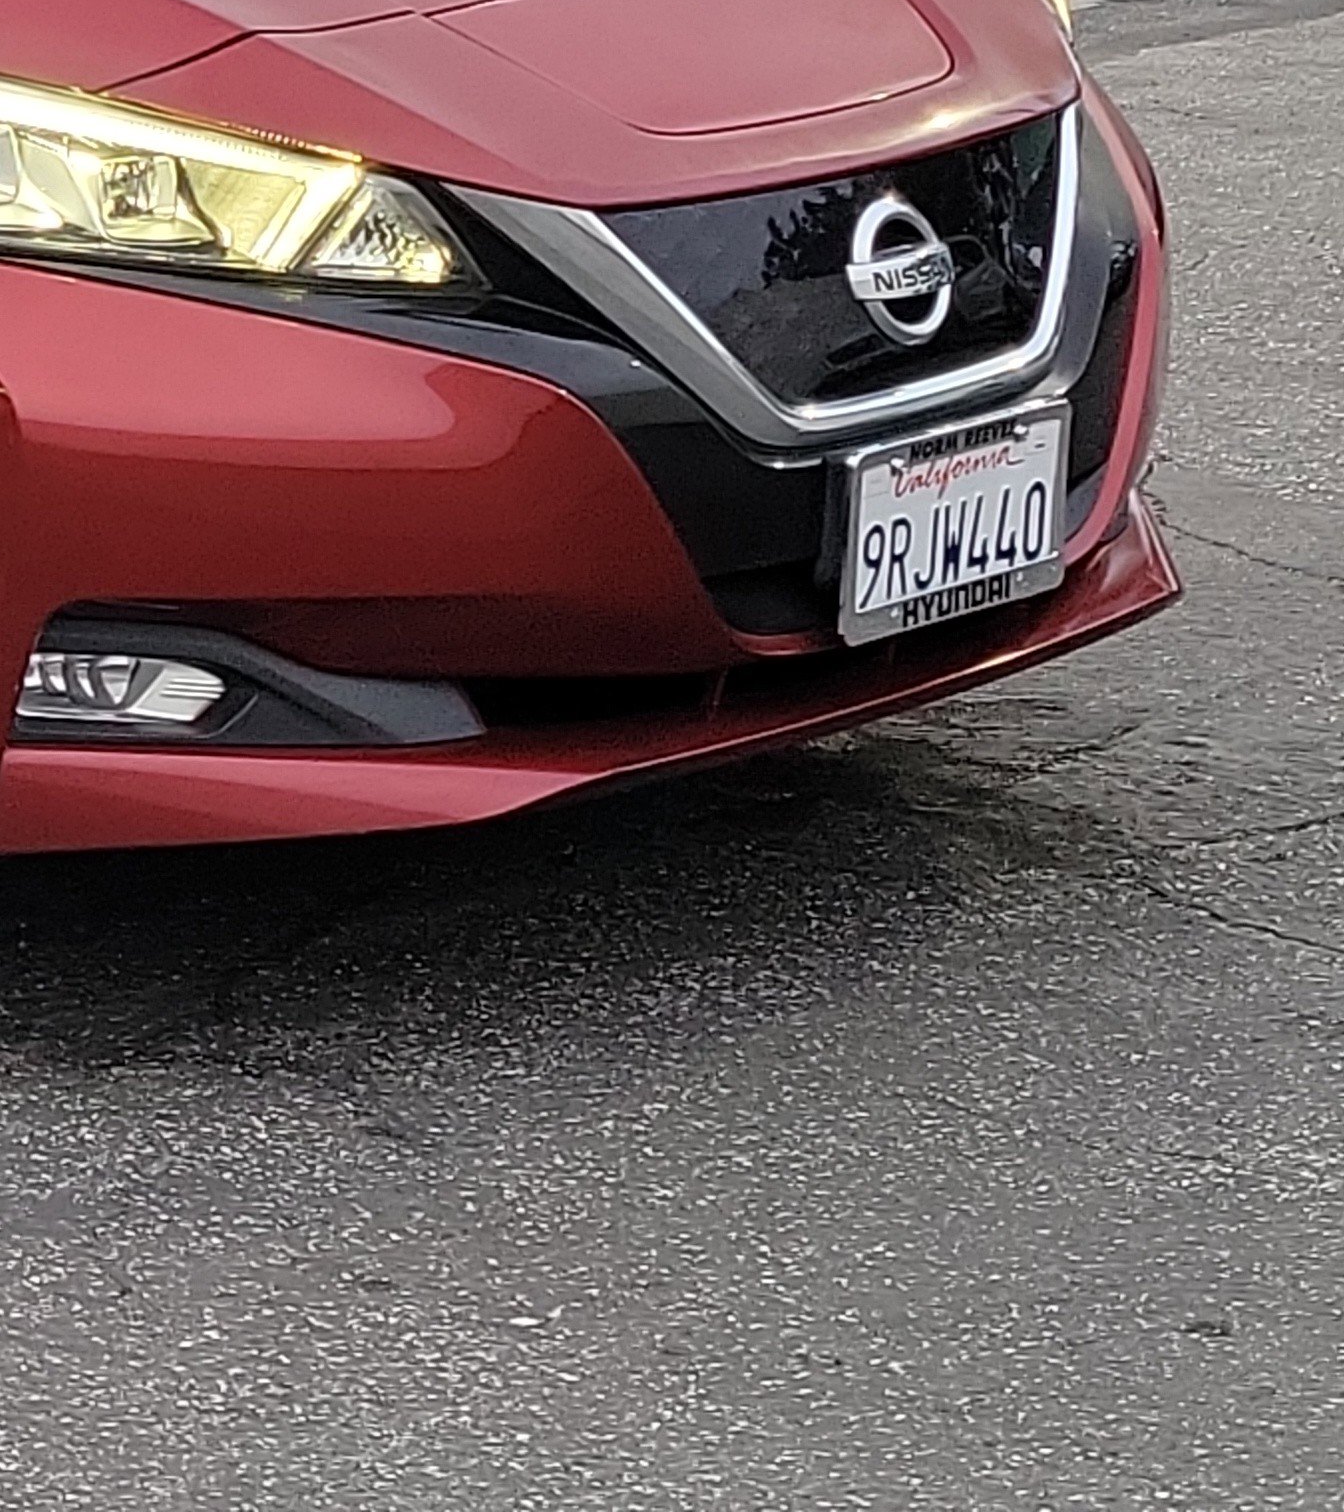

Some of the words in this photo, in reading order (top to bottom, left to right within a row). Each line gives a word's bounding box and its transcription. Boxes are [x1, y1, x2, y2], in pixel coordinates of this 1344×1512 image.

[892, 445, 1025, 499] California
[909, 432, 958, 464] NORM
[859, 480, 1046, 610] 9RJW440
[902, 572, 1010, 628] HYUNDAI
